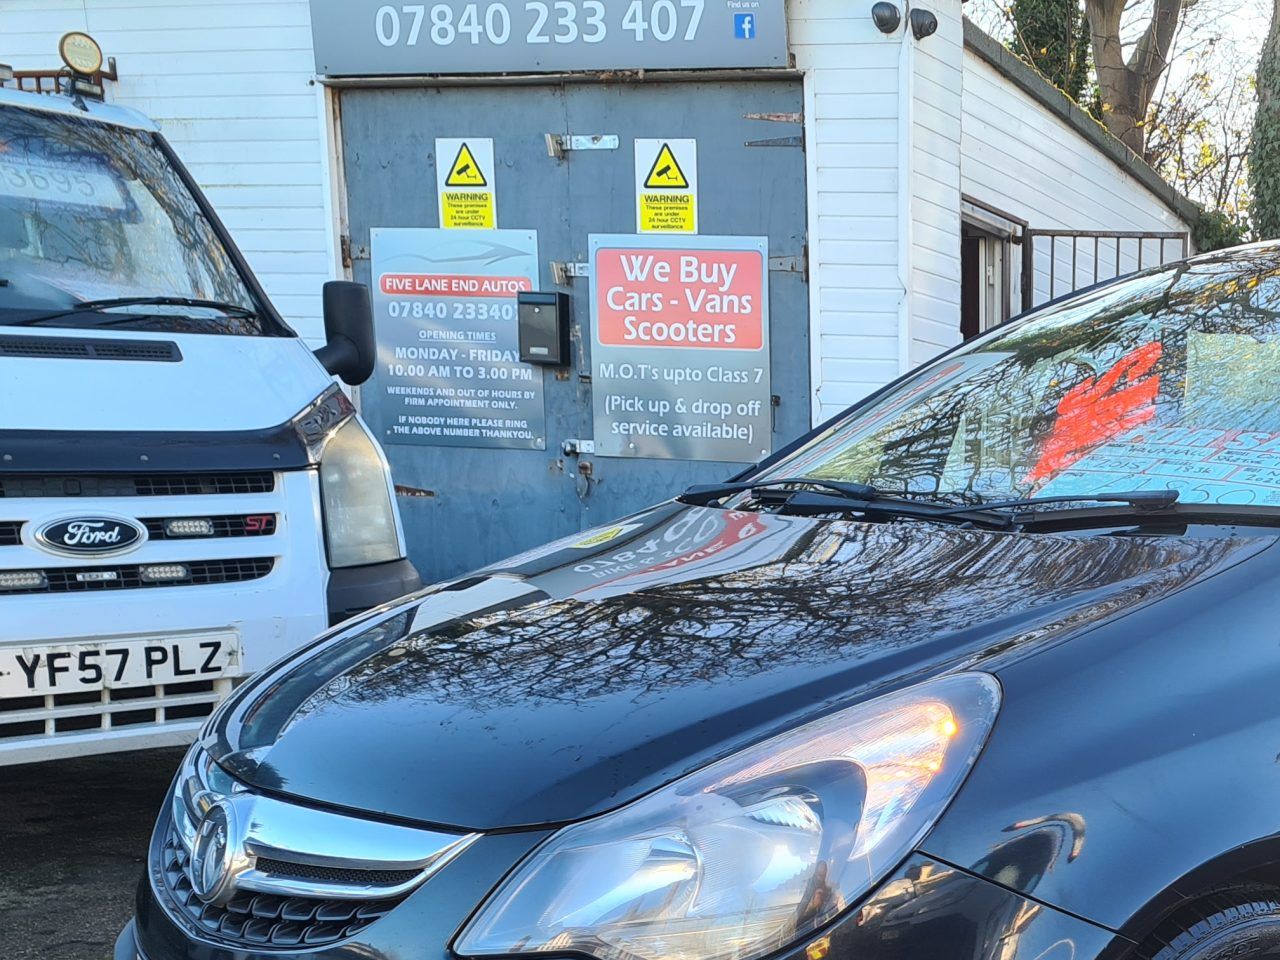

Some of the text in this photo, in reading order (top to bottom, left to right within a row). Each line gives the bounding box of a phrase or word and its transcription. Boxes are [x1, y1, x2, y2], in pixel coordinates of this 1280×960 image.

[727, 0, 741, 8] Find
[375, 0, 705, 47] 07840 233 407
[446, 192, 488, 201] WARNING
[644, 195, 690, 203] WARNING
[620, 255, 738, 293] We Buy
[385, 278, 526, 293] FIVE LANE END AUTOS
[606, 287, 664, 312] Cars
[684, 288, 753, 315] Vans
[388, 301, 448, 319] 07840
[418, 330, 497, 342] OPENING TIMES
[623, 316, 737, 344] Scooters
[395, 347, 459, 361] MONDAY
[469, 349, 520, 363] FRIDAY
[387, 365, 533, 381] 10.00 AM TO 3.00 PM
[599, 363, 763, 385] M.O.T's upto Class 7
[386, 386, 535, 399] WEEKENDS AND OUT OF HOURS BY
[404, 397, 518, 409] FIRM APPOINTMENT ONLY.
[605, 395, 762, 420] (Pick up & drop off
[398, 416, 528, 428] IF NOBODY HERE PLEASE RING
[392, 426, 534, 440] THE ABOVE NUMBER THANKYOU.
[611, 419, 753, 445] service available)
[245, 516, 273, 530] ST
[63, 521, 121, 545] Ford
[15, 641, 222, 689] YF57 PLZ
